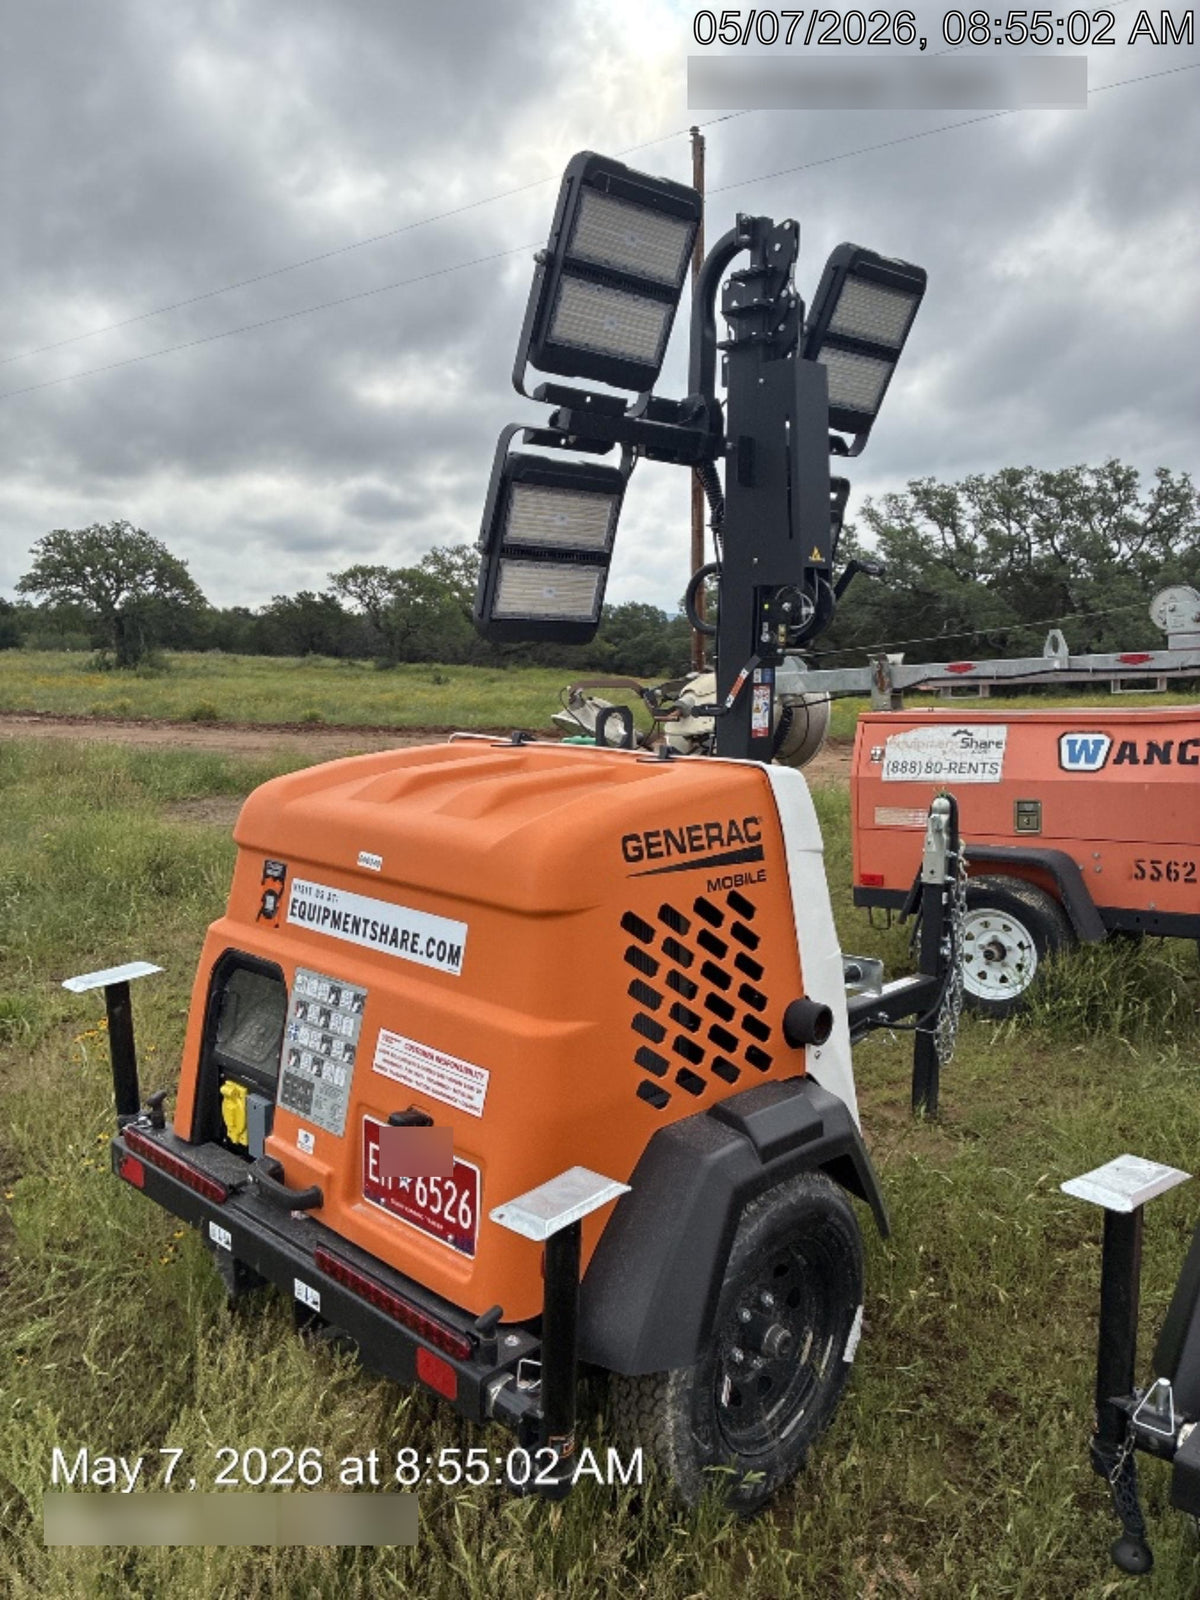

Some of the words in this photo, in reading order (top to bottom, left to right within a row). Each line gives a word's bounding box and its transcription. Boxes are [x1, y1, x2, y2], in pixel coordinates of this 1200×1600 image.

[886, 760, 922, 776] (888)
[924, 761, 1000, 776] 80-RENTS
[621, 816, 762, 863] GENERAC
[706, 869, 767, 893] MOBILE
[1134, 859, 1197, 884] 5562
[289, 897, 462, 967] EQUIPMENTSHARE.COM
